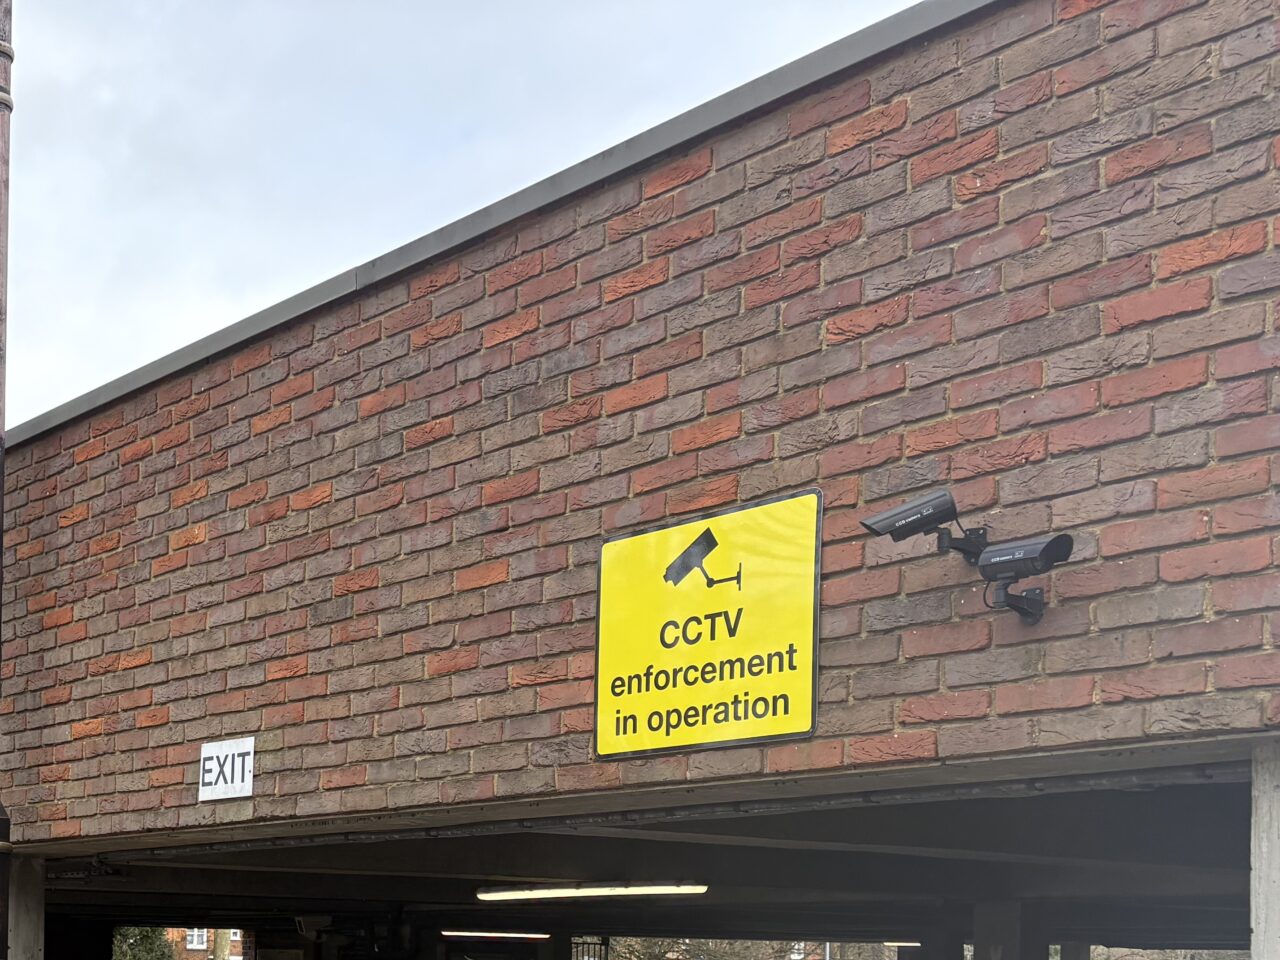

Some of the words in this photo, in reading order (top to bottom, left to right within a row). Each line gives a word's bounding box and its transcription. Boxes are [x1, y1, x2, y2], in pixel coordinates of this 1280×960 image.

[660, 608, 743, 649] CCTV
[611, 643, 797, 697] enforcement
[615, 709, 638, 736] in
[647, 692, 789, 736] operation
[201, 751, 251, 788] EXIT
